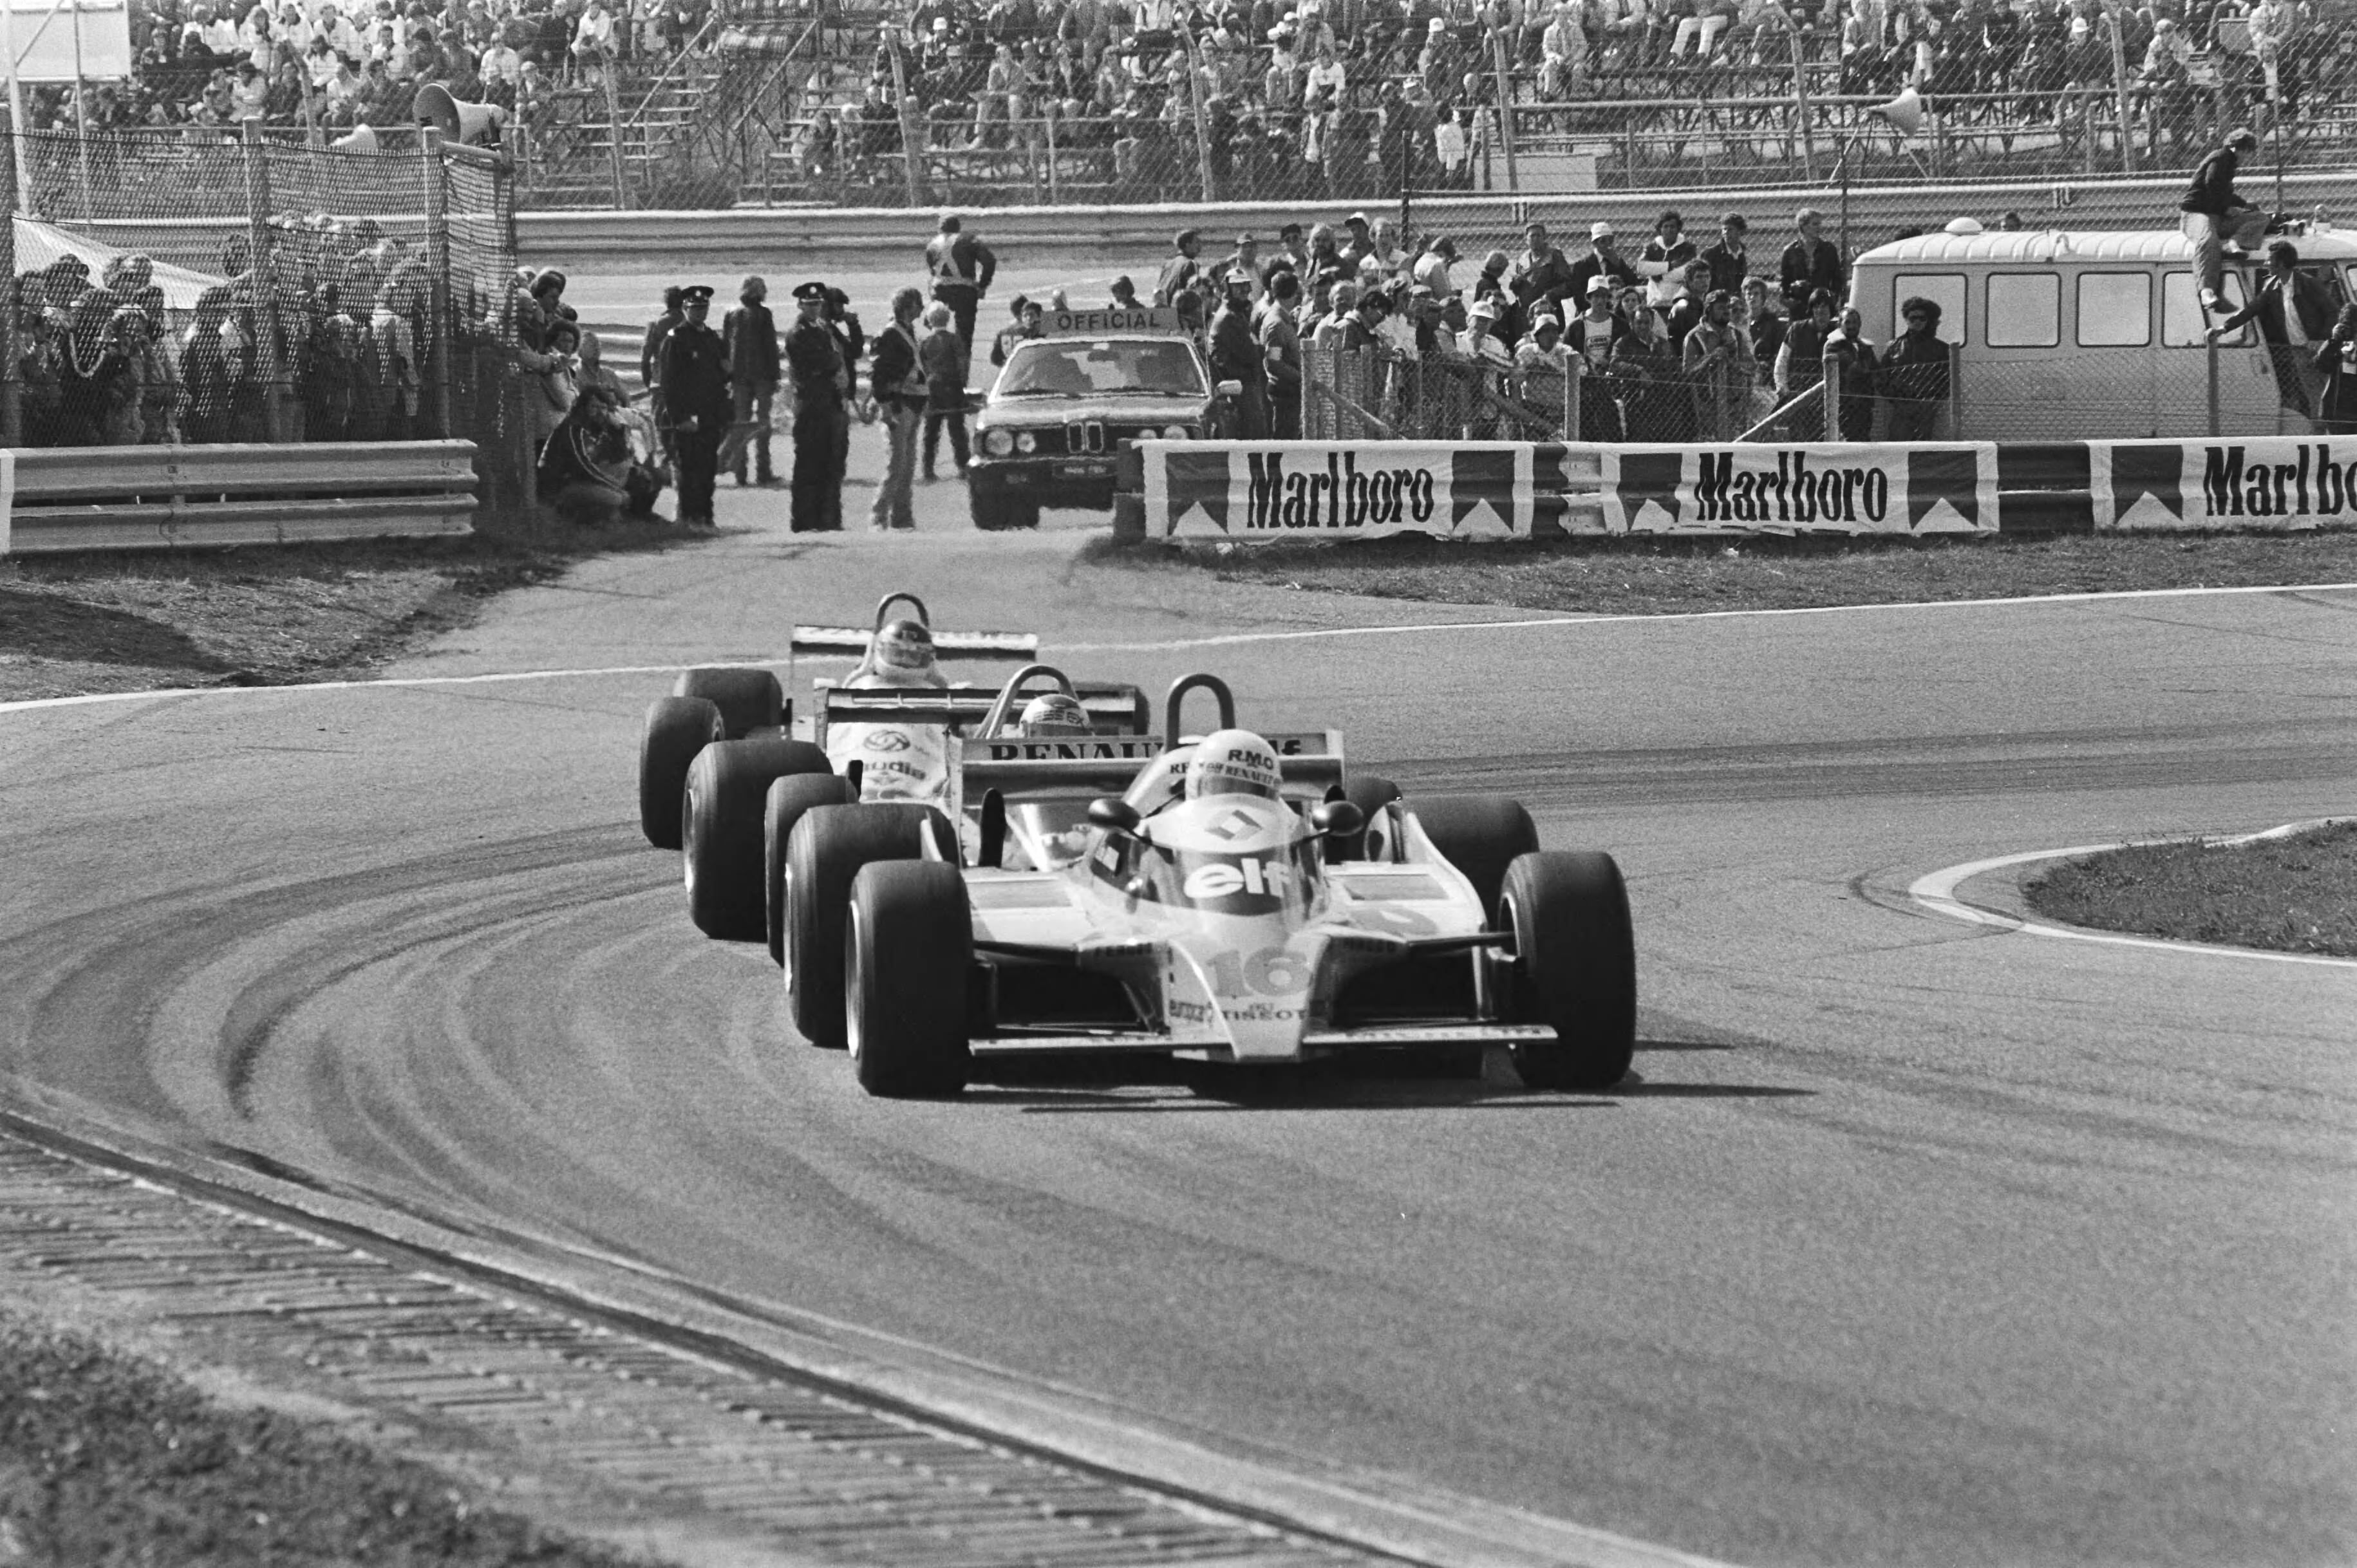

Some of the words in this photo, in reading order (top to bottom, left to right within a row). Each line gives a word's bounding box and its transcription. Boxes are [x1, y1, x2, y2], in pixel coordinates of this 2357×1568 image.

[1058, 312, 1161, 330] OFFICIAL
[1247, 451, 1434, 529] Marlboro
[1694, 451, 1888, 523] Marlboro
[1183, 857, 1291, 899] elf
[1207, 946, 1310, 997] 16
